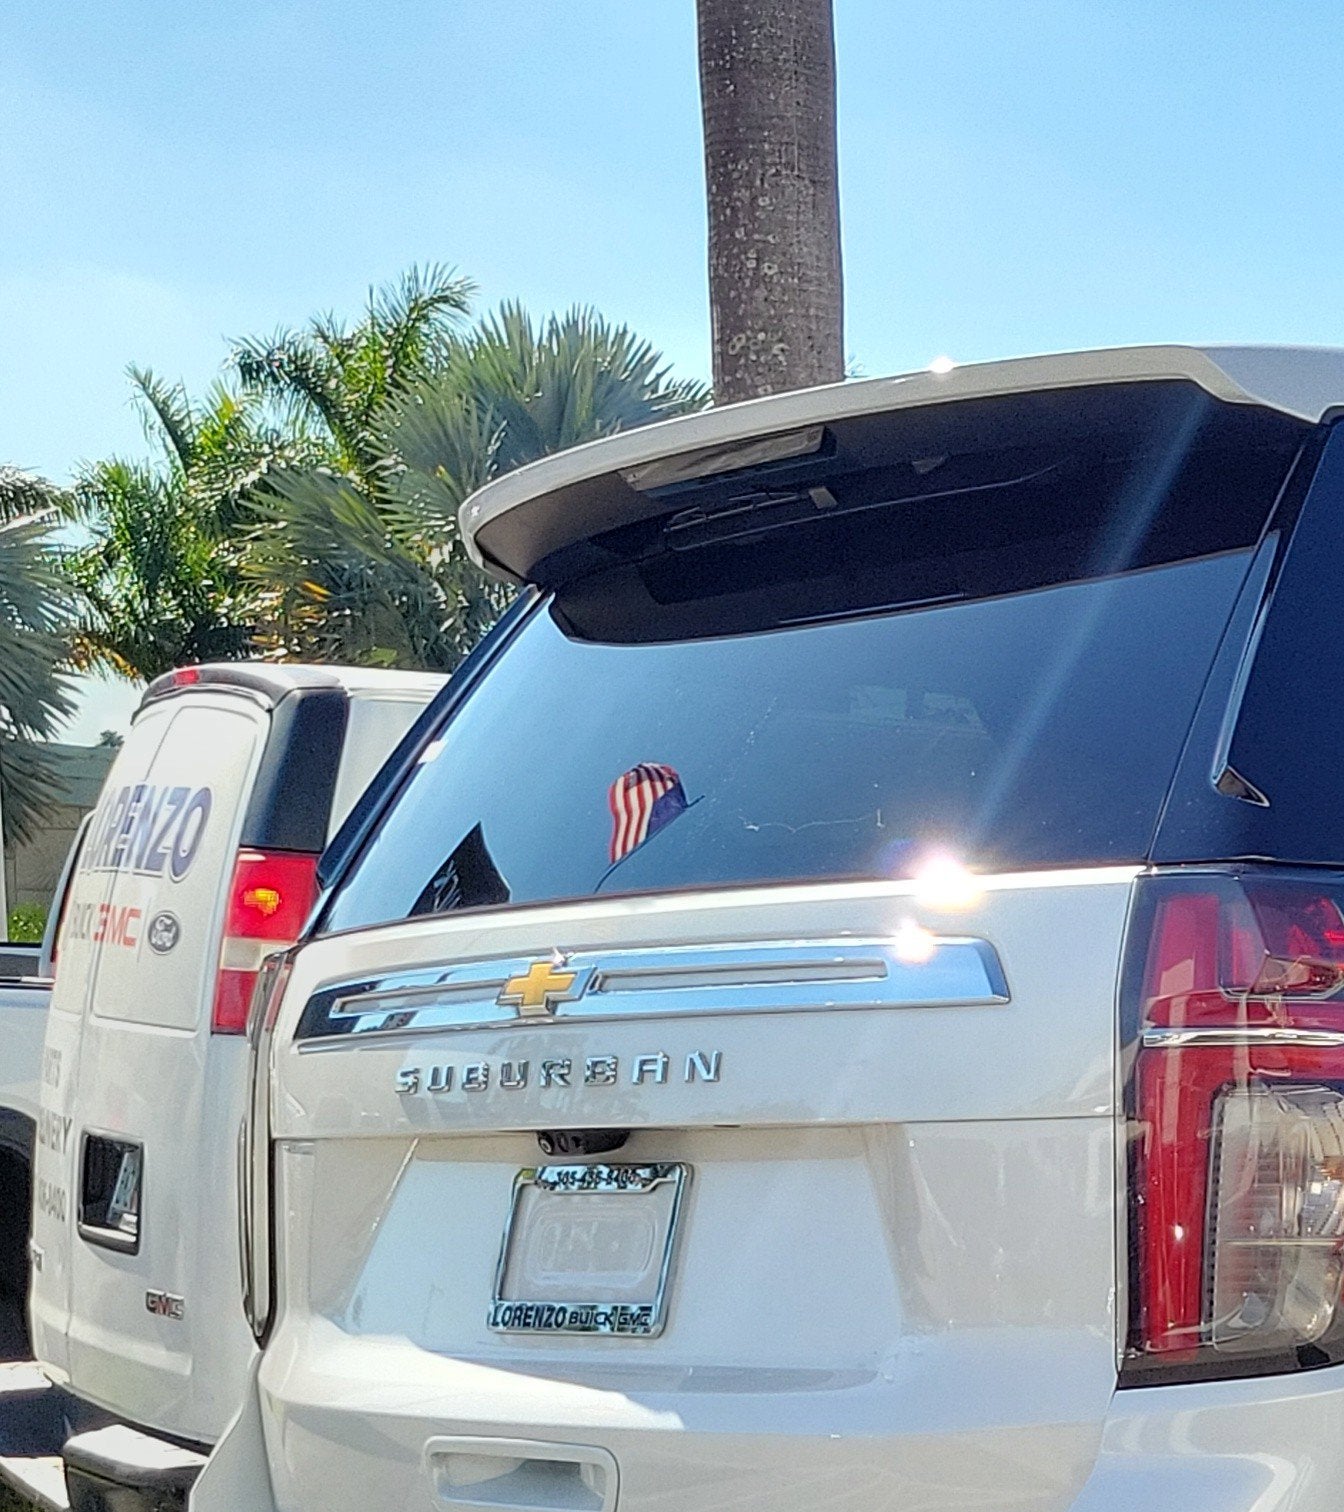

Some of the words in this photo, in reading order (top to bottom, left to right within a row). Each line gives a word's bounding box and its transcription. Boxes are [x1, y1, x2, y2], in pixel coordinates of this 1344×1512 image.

[394, 1049, 722, 1095] SUBURBAN
[490, 1300, 568, 1328] LORENZO
[567, 1309, 615, 1327] BUICK
